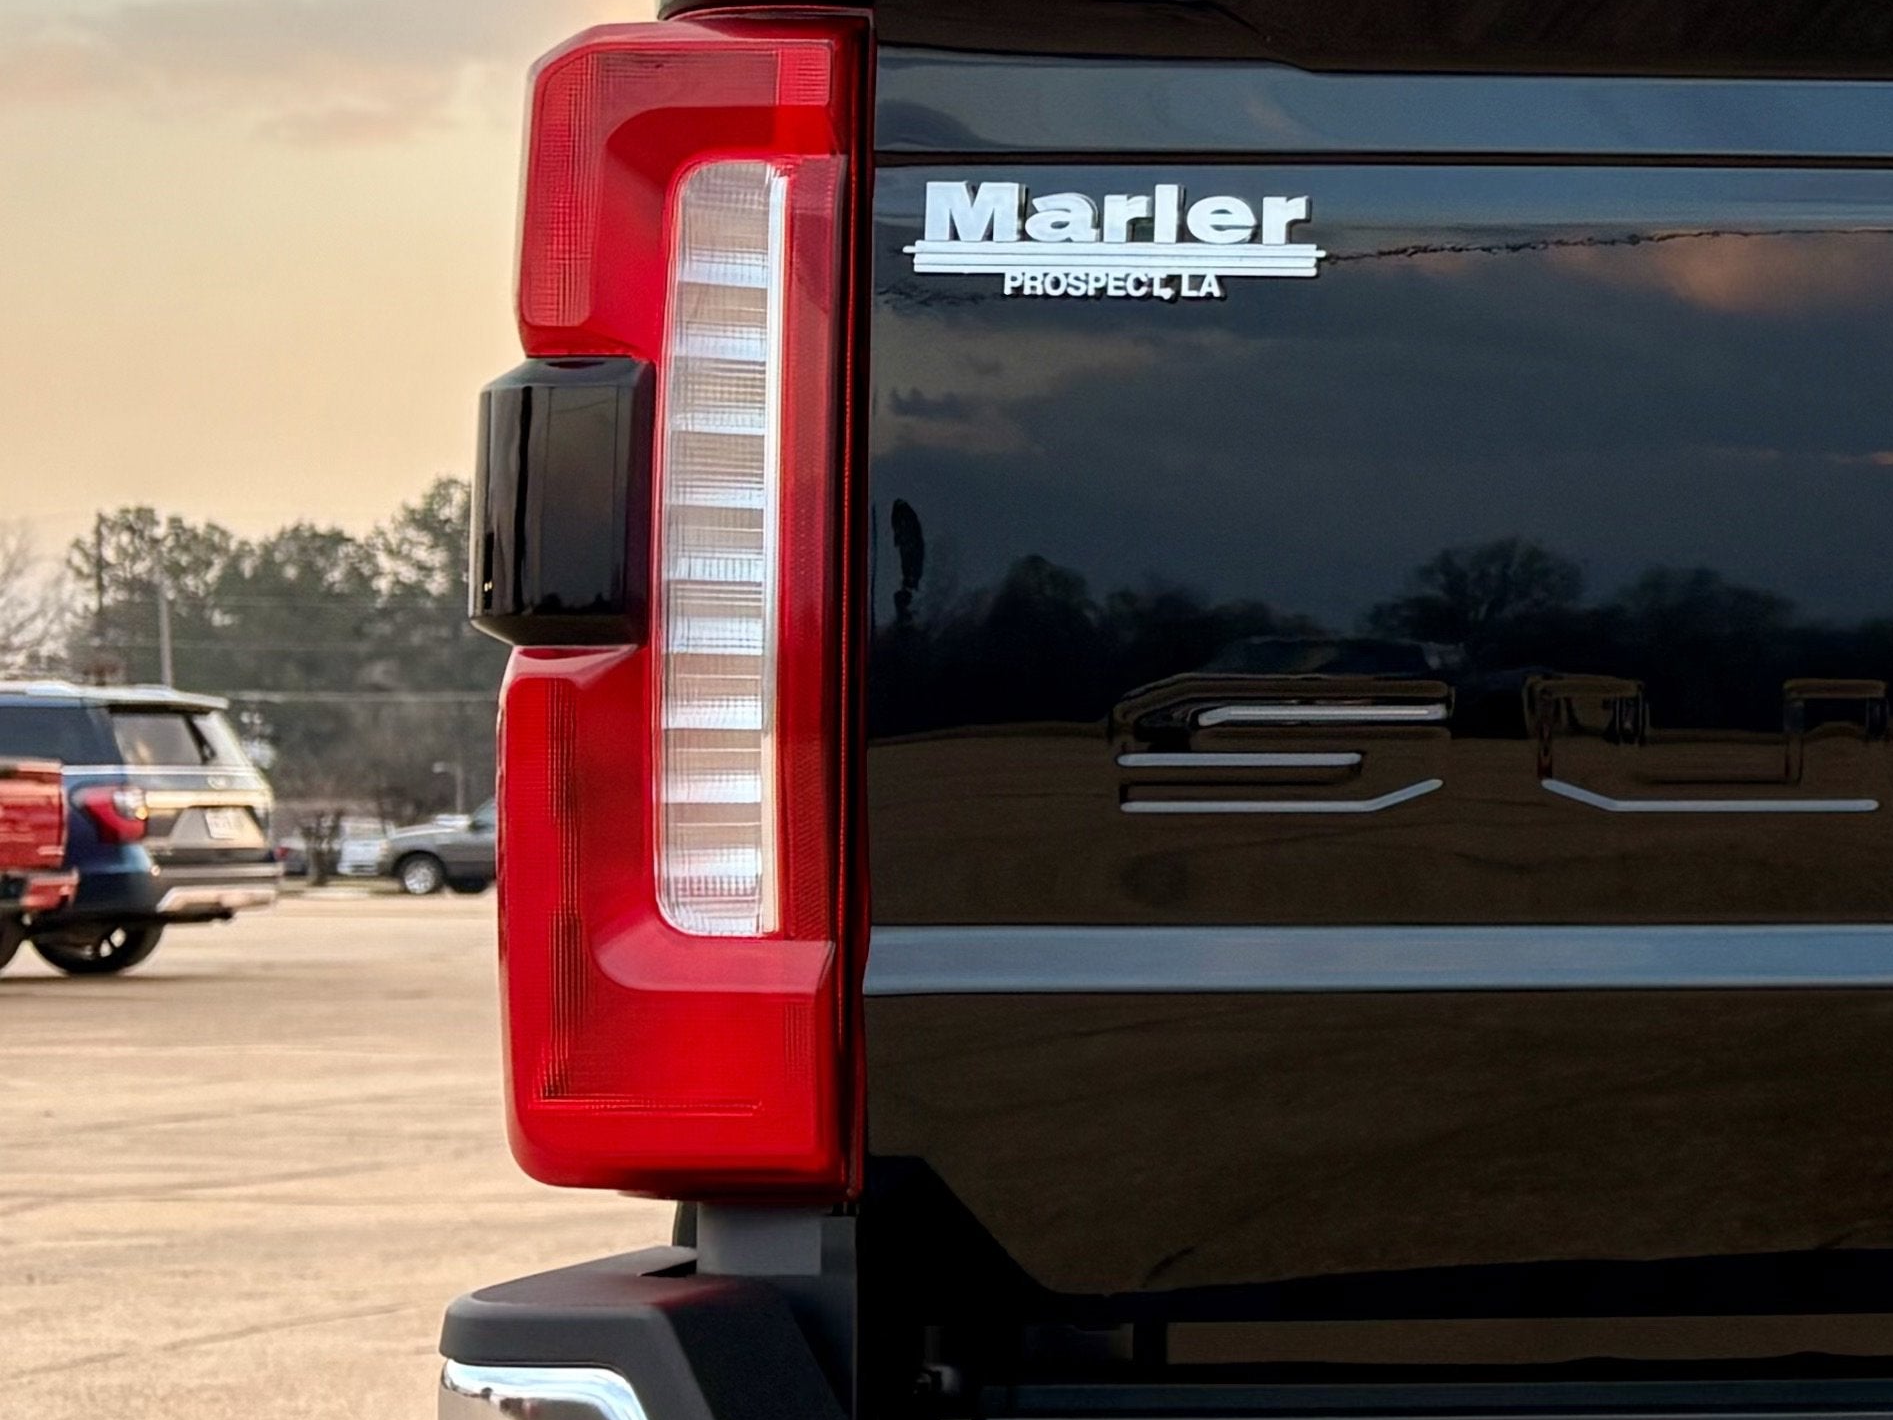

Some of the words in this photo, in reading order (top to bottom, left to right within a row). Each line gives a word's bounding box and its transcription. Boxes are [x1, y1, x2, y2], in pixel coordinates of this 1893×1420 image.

[925, 181, 1311, 245] Marler
[1003, 272, 1172, 300] PROSPECT,
[1180, 272, 1221, 298] LA
